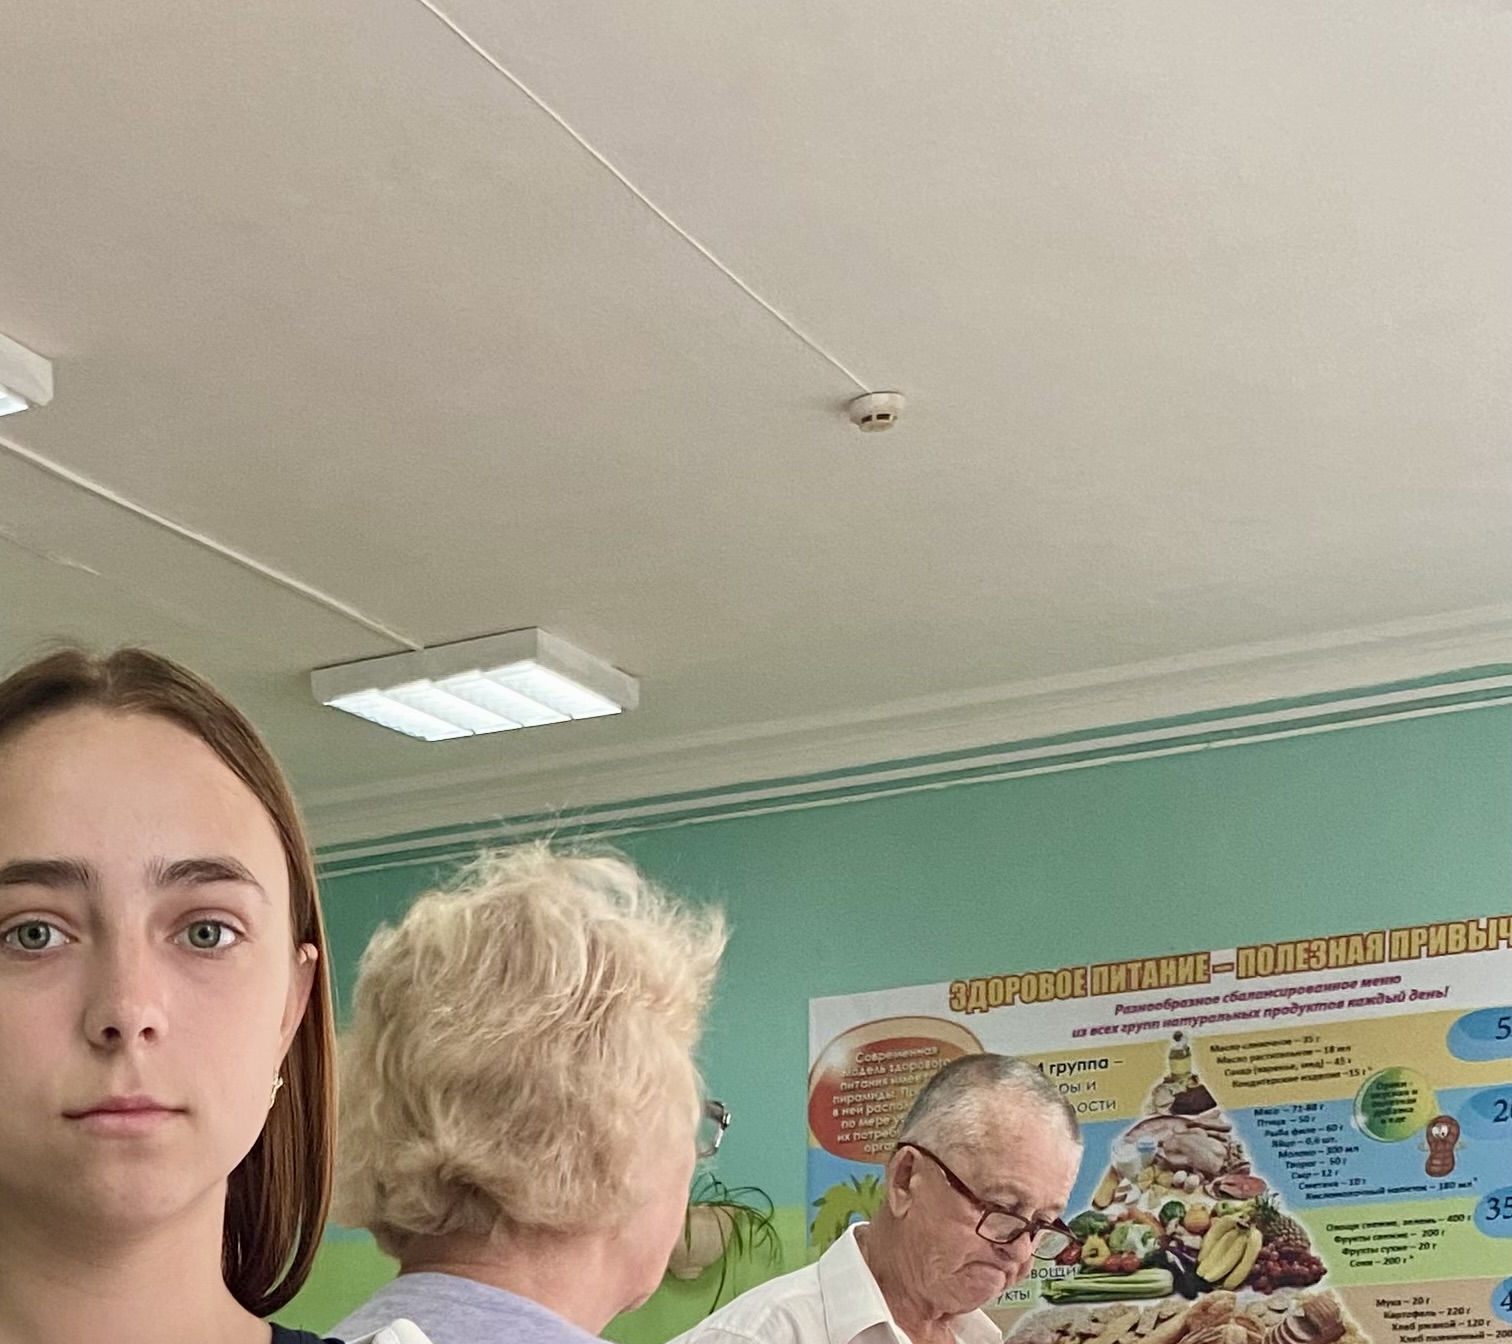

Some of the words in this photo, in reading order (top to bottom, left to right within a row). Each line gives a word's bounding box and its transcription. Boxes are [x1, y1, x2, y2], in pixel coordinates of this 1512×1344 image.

[949, 966, 1088, 1014] ЗДОРОВОЕ
[1090, 952, 1211, 996] ПИТАНИЕ
[1236, 931, 1386, 980] ПОЛЕЗНАЯ
[1072, 1028, 1087, 1038] из
[1090, 1024, 1119, 1036] всех
[1121, 1020, 1160, 1035] групп
[1162, 1009, 1260, 1028] натуральных
[1263, 1000, 1345, 1019] продуктов
[1347, 991, 1406, 1007] каждый
[1409, 985, 1450, 1001] день!
[1114, 996, 1220, 1016] Разнообразное
[1223, 980, 1358, 1003] сбалансированное
[1360, 975, 1402, 988] меню
[1049, 1058, 1109, 1077] группа
[1031, 1266, 1076, 1279] вощи
